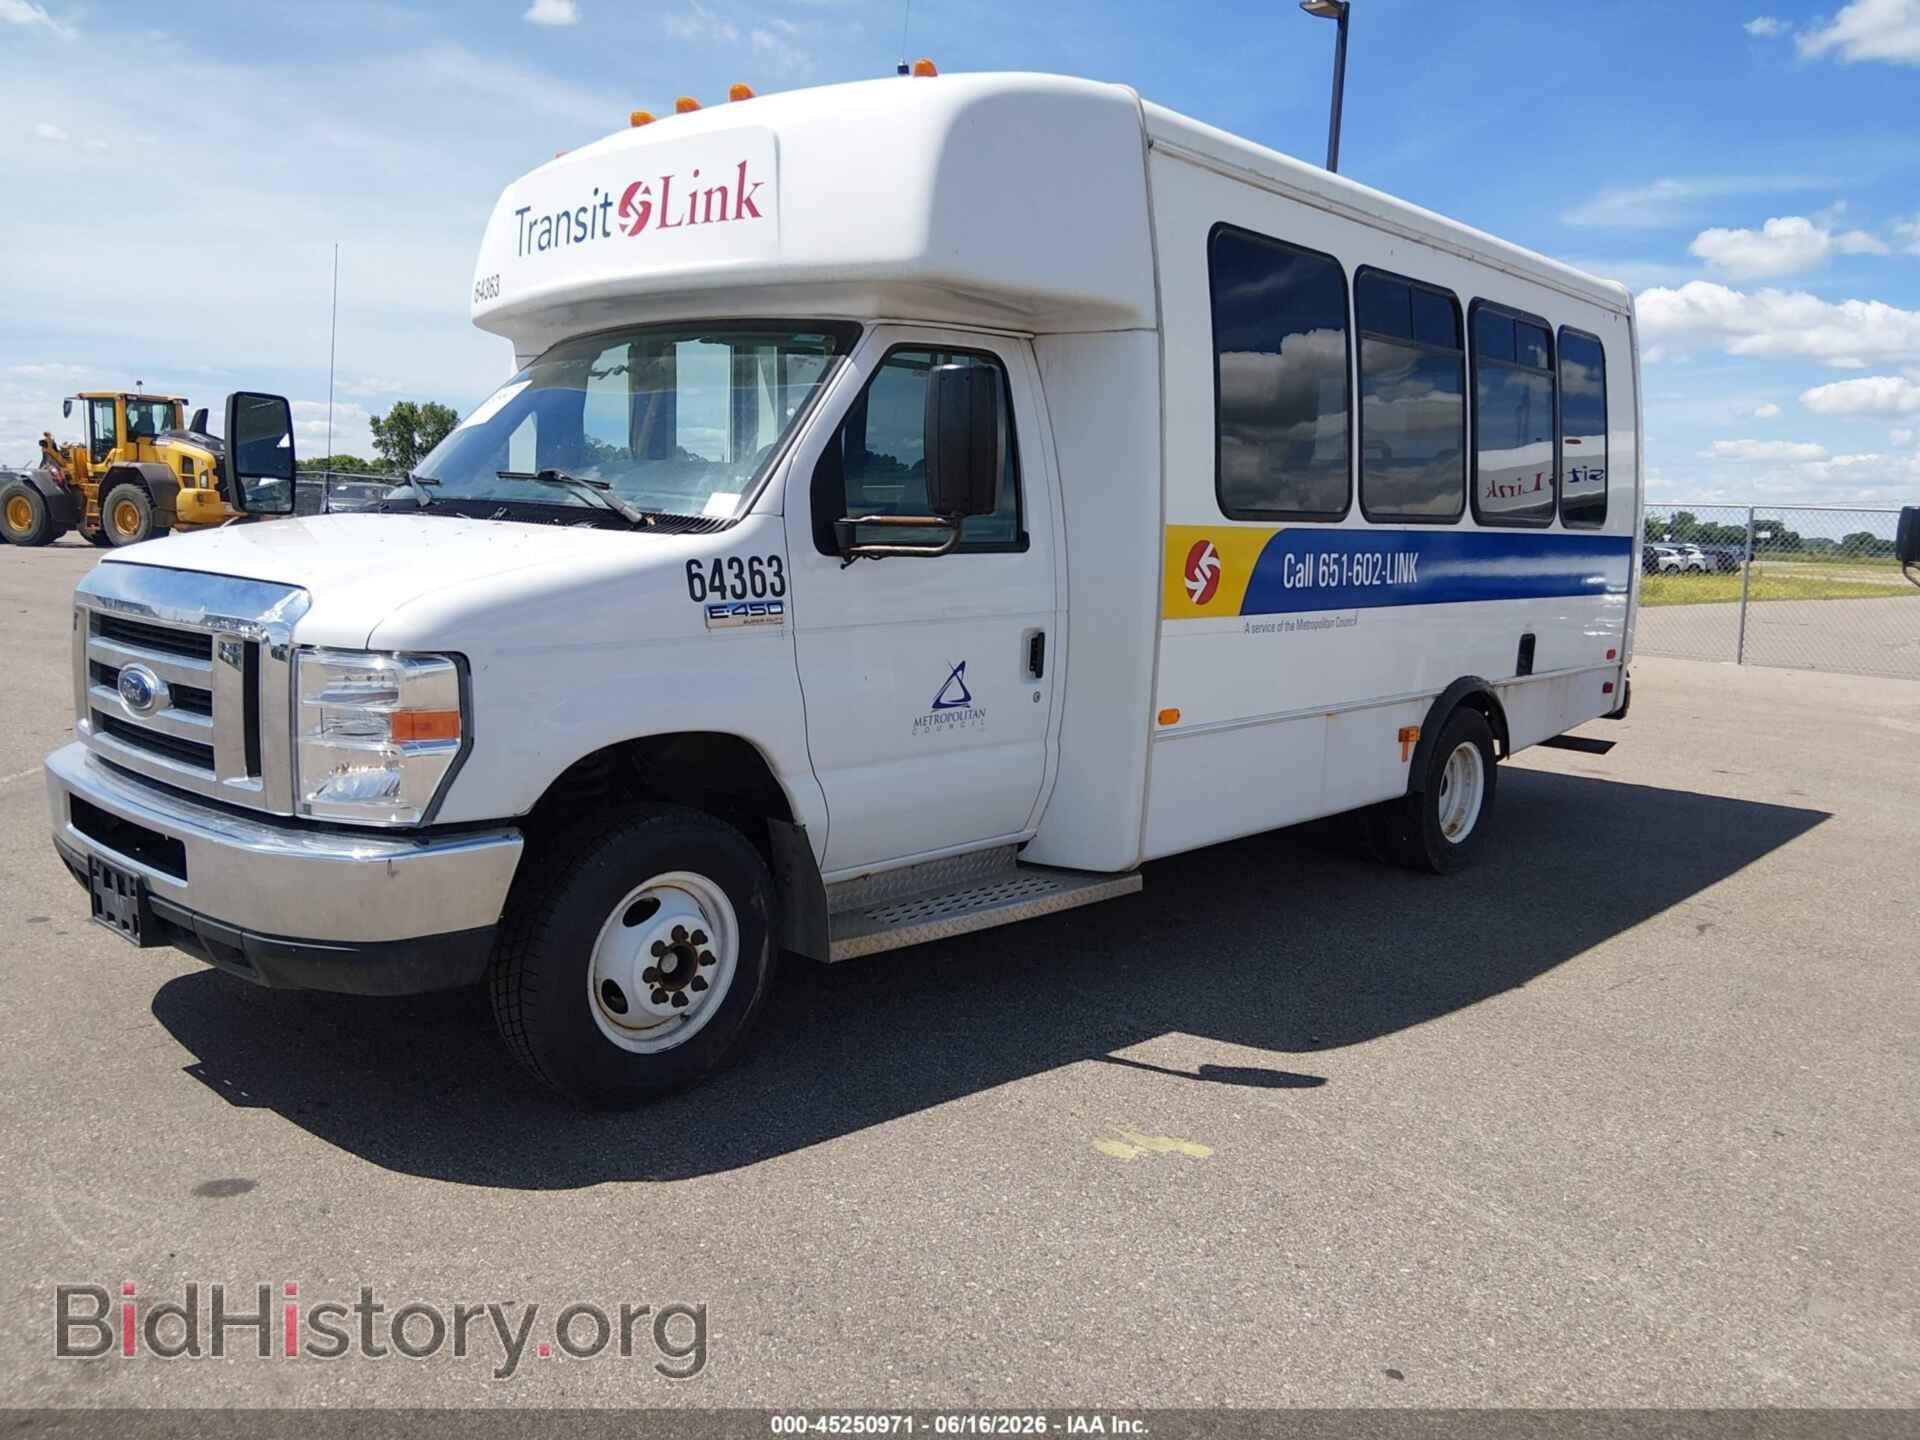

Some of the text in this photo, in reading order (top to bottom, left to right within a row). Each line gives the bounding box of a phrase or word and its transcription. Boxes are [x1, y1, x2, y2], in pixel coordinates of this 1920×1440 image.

[515, 160, 768, 257] Transit Link
[686, 555, 786, 602] 64363
[1283, 552, 1419, 589] Call 651-602-LINK
[1251, 622, 1276, 634] service
[1277, 620, 1284, 632] of
[1285, 620, 1295, 632] the
[913, 708, 986, 727] METROPOLITAN
